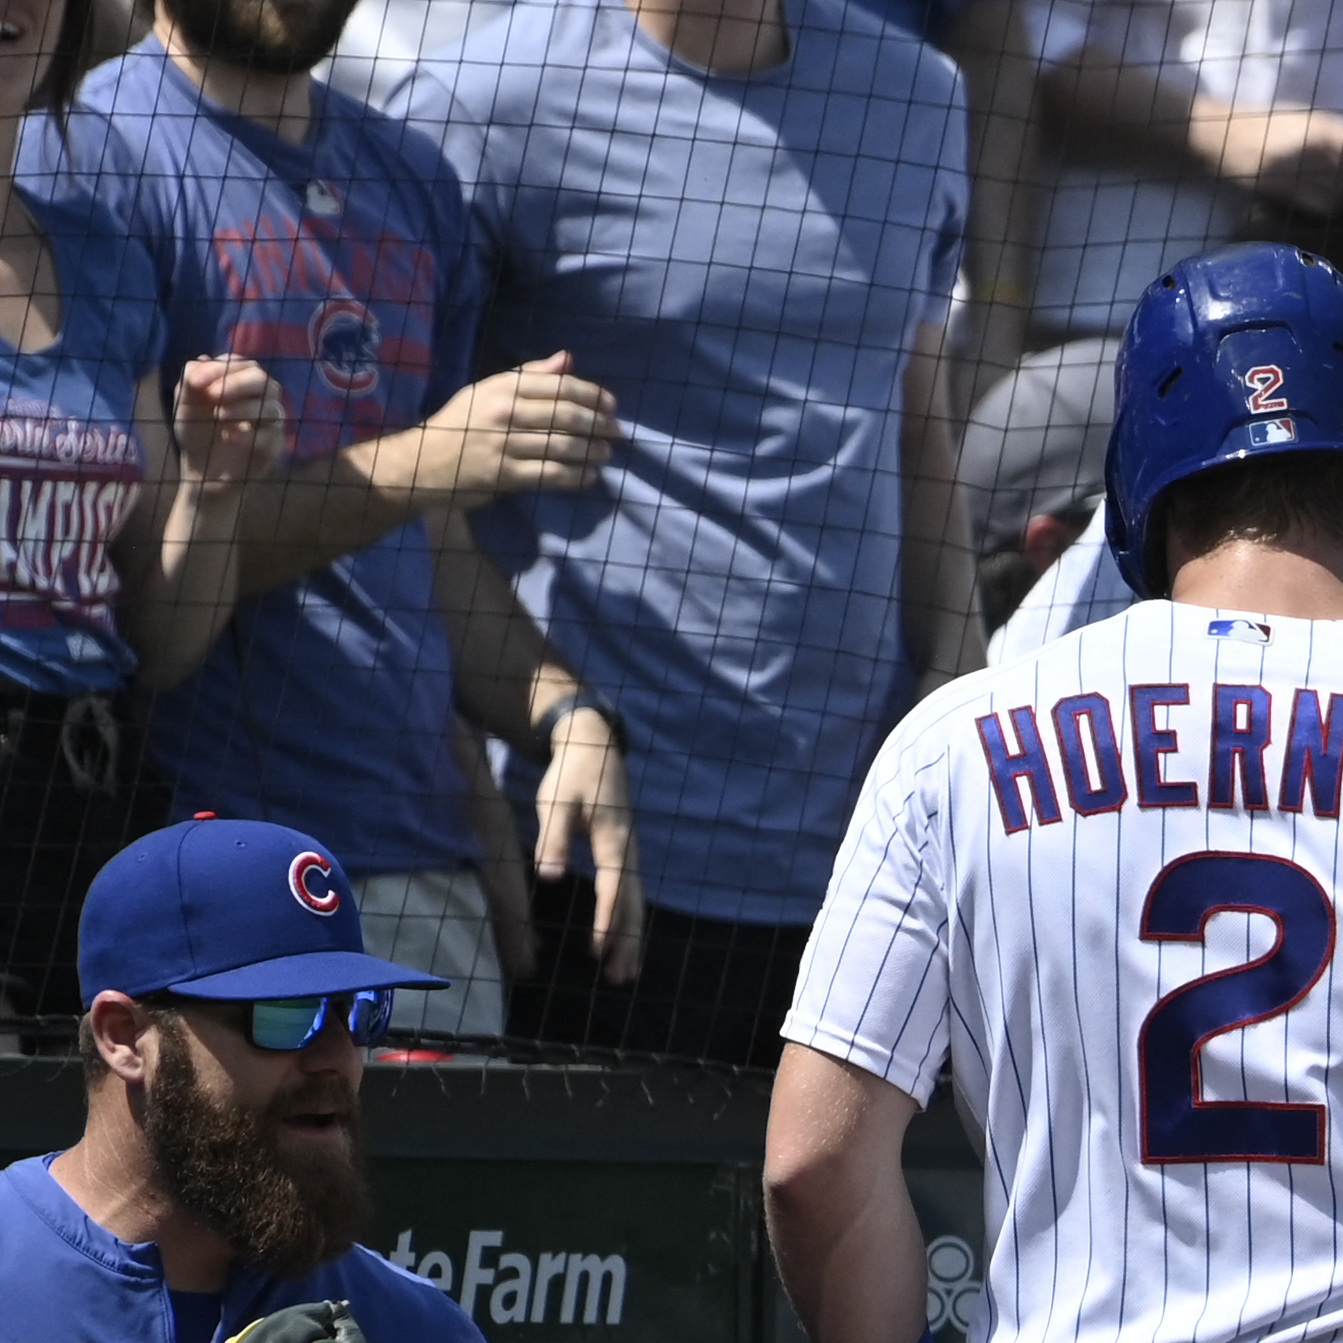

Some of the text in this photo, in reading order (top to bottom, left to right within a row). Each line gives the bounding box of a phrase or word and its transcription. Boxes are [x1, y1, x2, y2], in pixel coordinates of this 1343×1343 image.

[1245, 365, 1288, 415] 2
[288, 851, 341, 916] C
[1138, 850, 1336, 1166] 2
